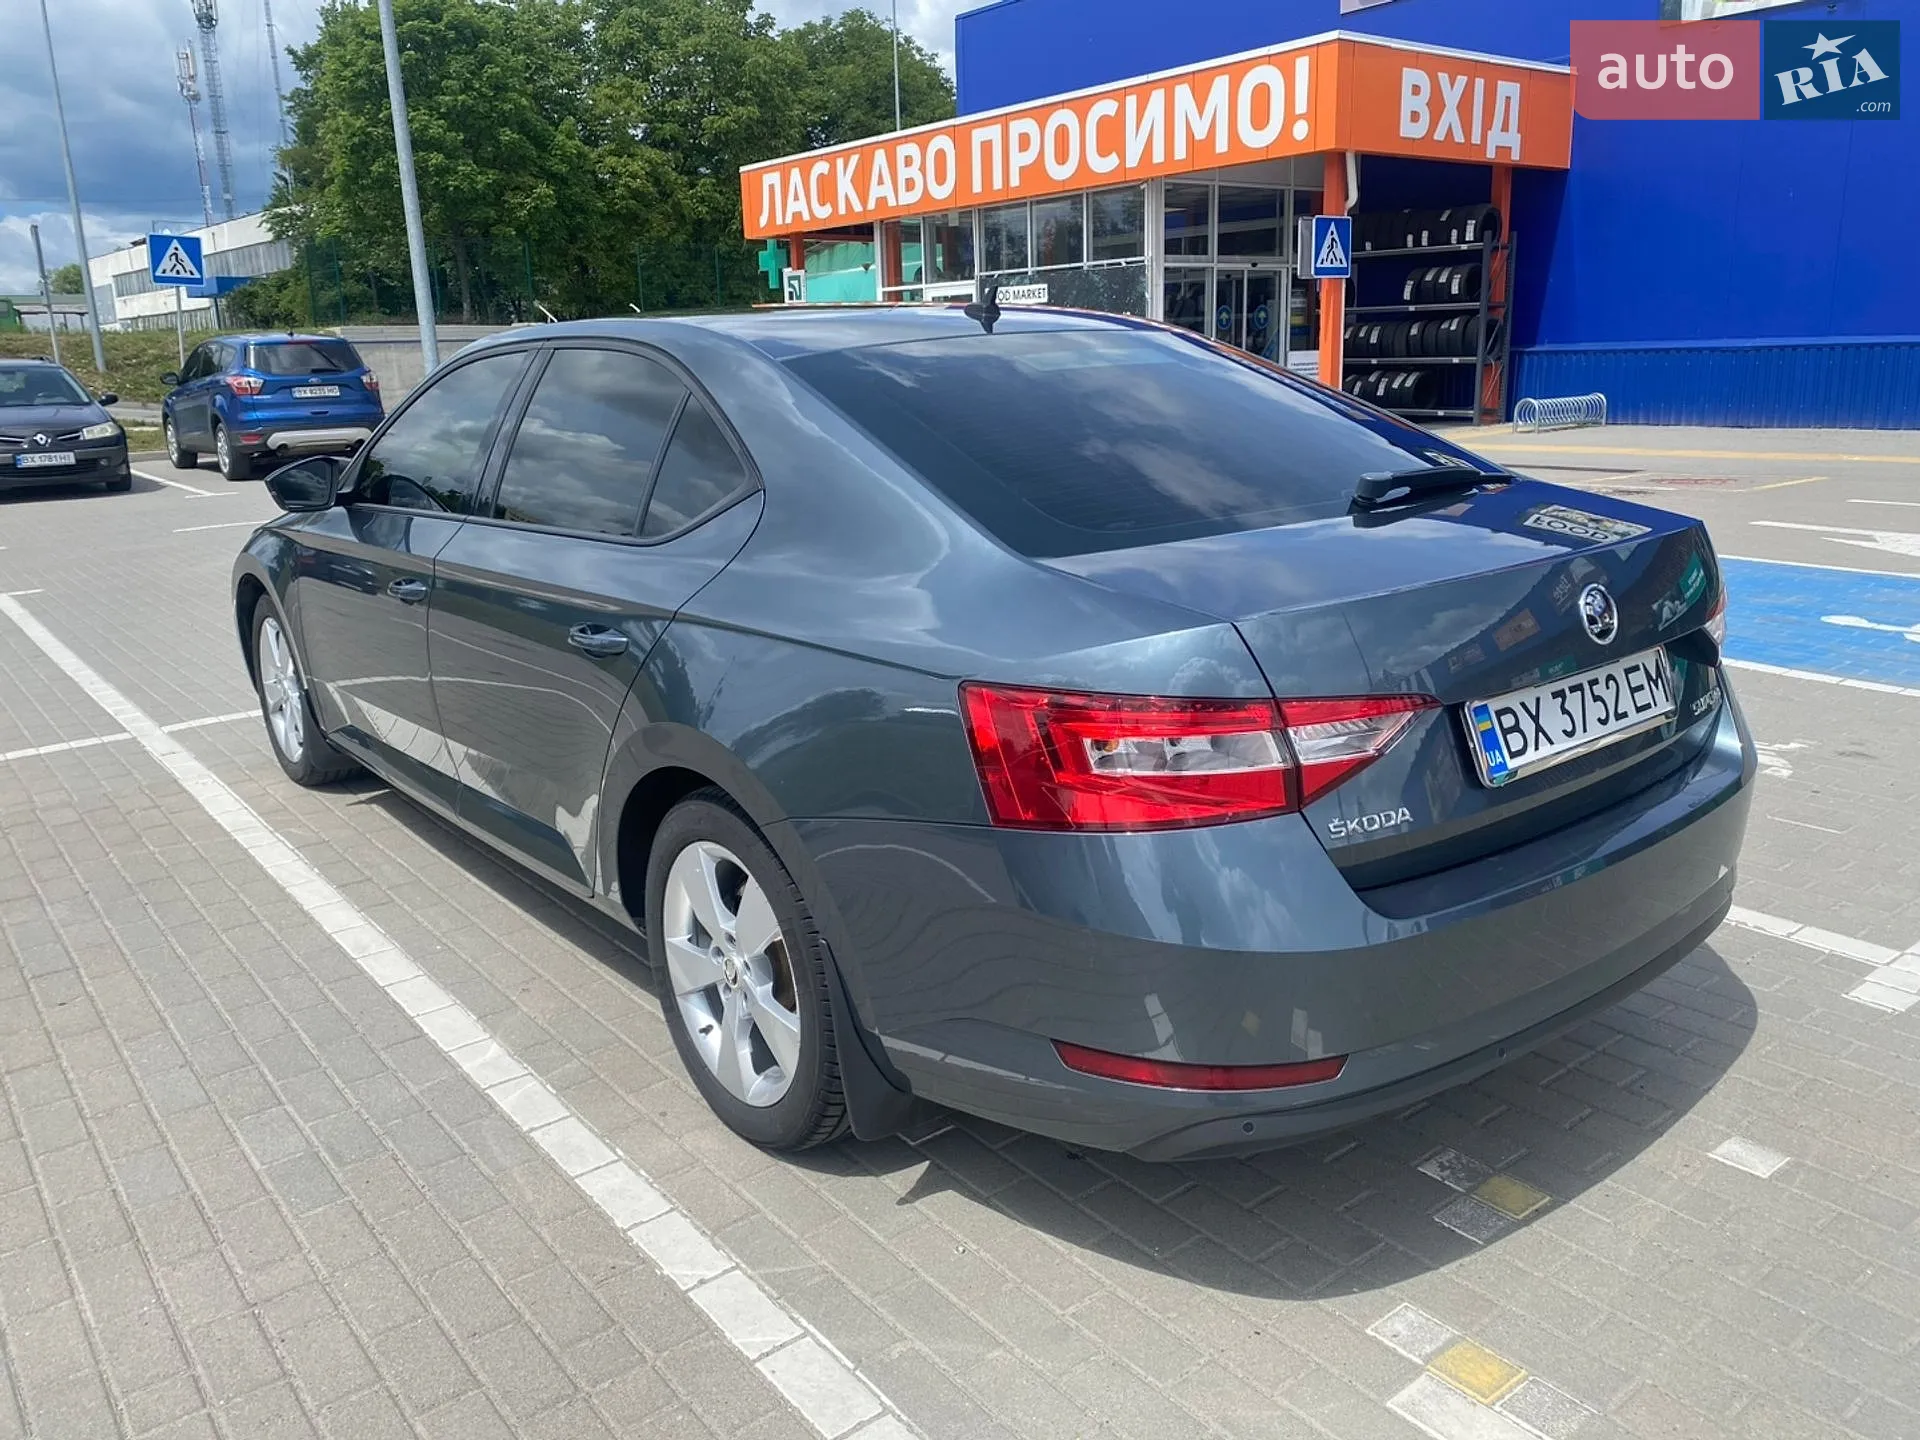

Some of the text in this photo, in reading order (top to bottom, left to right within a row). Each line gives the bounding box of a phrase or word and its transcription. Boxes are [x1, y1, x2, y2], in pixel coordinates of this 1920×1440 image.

[1399, 66, 1521, 160] ВХІД
[759, 55, 1309, 228] ЛАСКАВО ПРОСИМО!
[1012, 287, 1046, 300] MARKET
[22, 455, 36, 464] BX
[1494, 657, 1670, 759] BX 3752 EM
[1486, 749, 1504, 768] UA
[1328, 807, 1414, 839] ŠKODA
